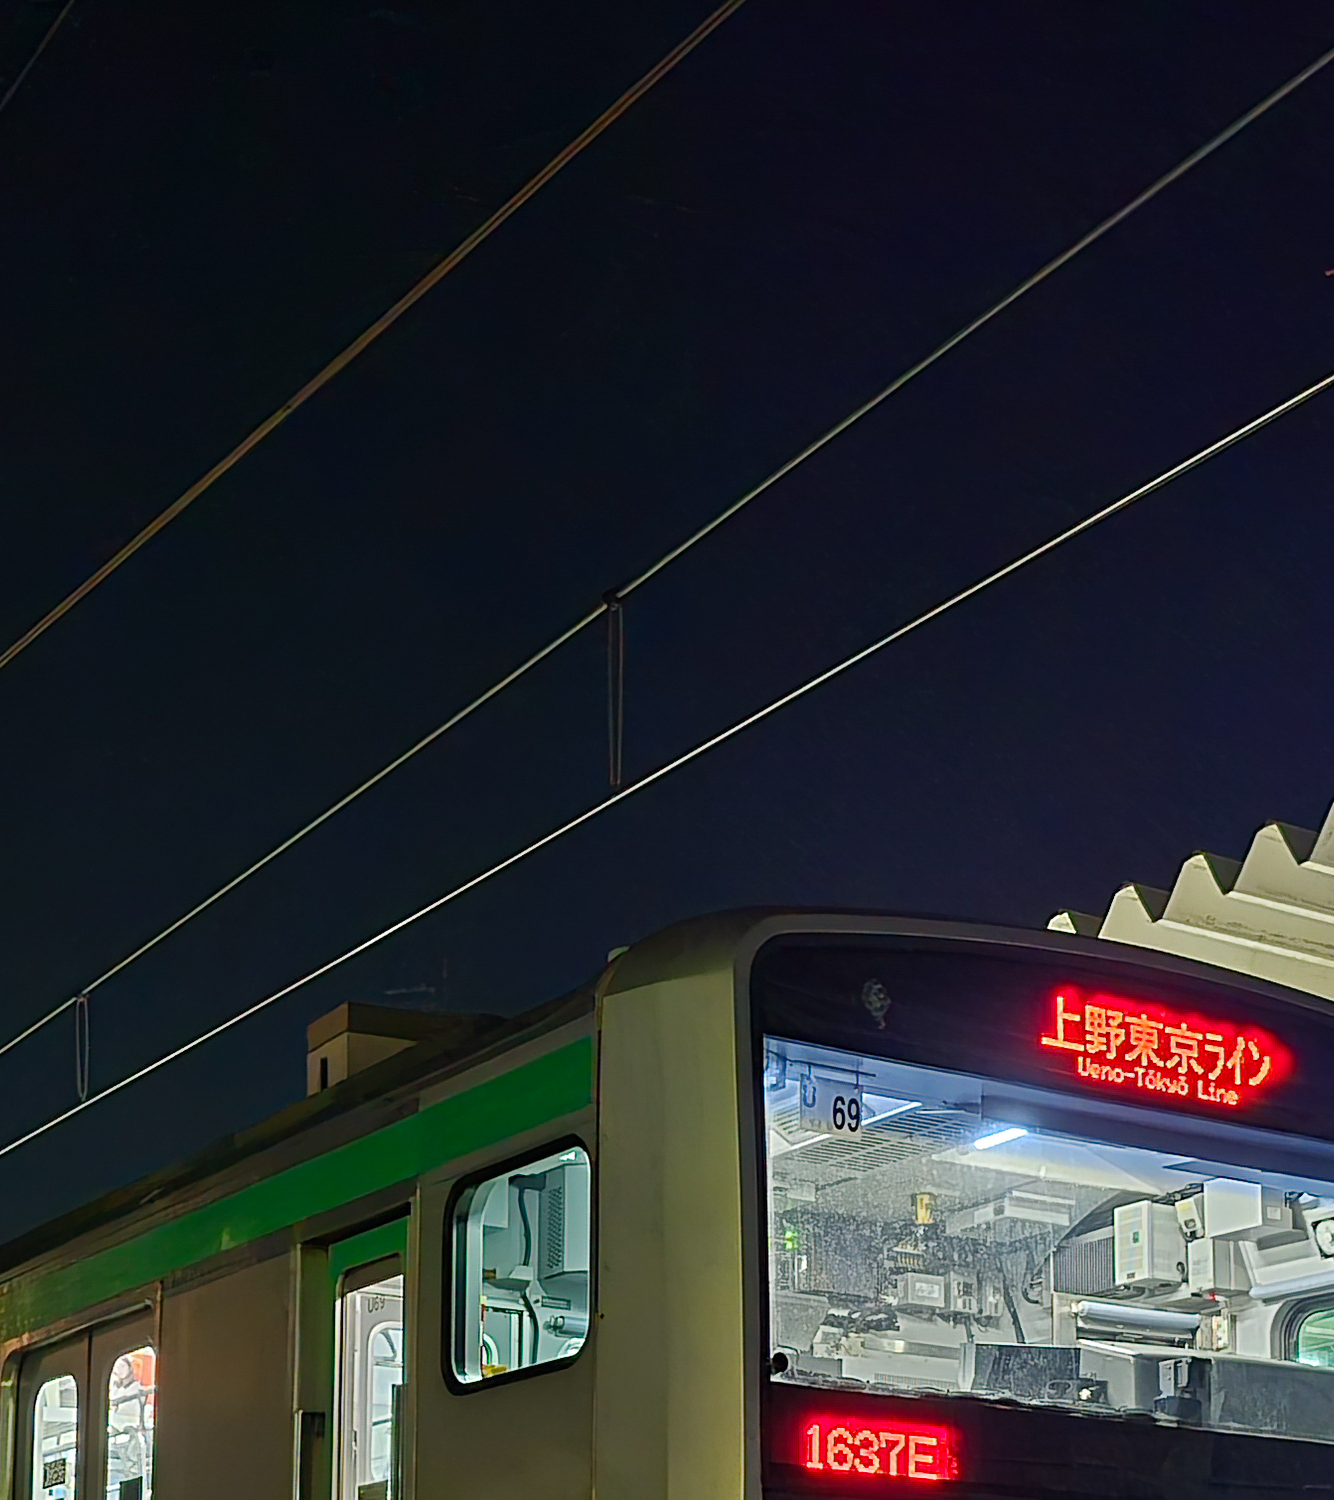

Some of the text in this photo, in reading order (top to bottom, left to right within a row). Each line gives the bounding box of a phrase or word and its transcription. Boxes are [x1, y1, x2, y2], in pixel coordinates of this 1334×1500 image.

[1041, 996, 1270, 1086] 上野東京ライン
[832, 1096, 860, 1133] 69
[1197, 1080, 1239, 1105] Line
[806, 1424, 938, 1480] 1637E
